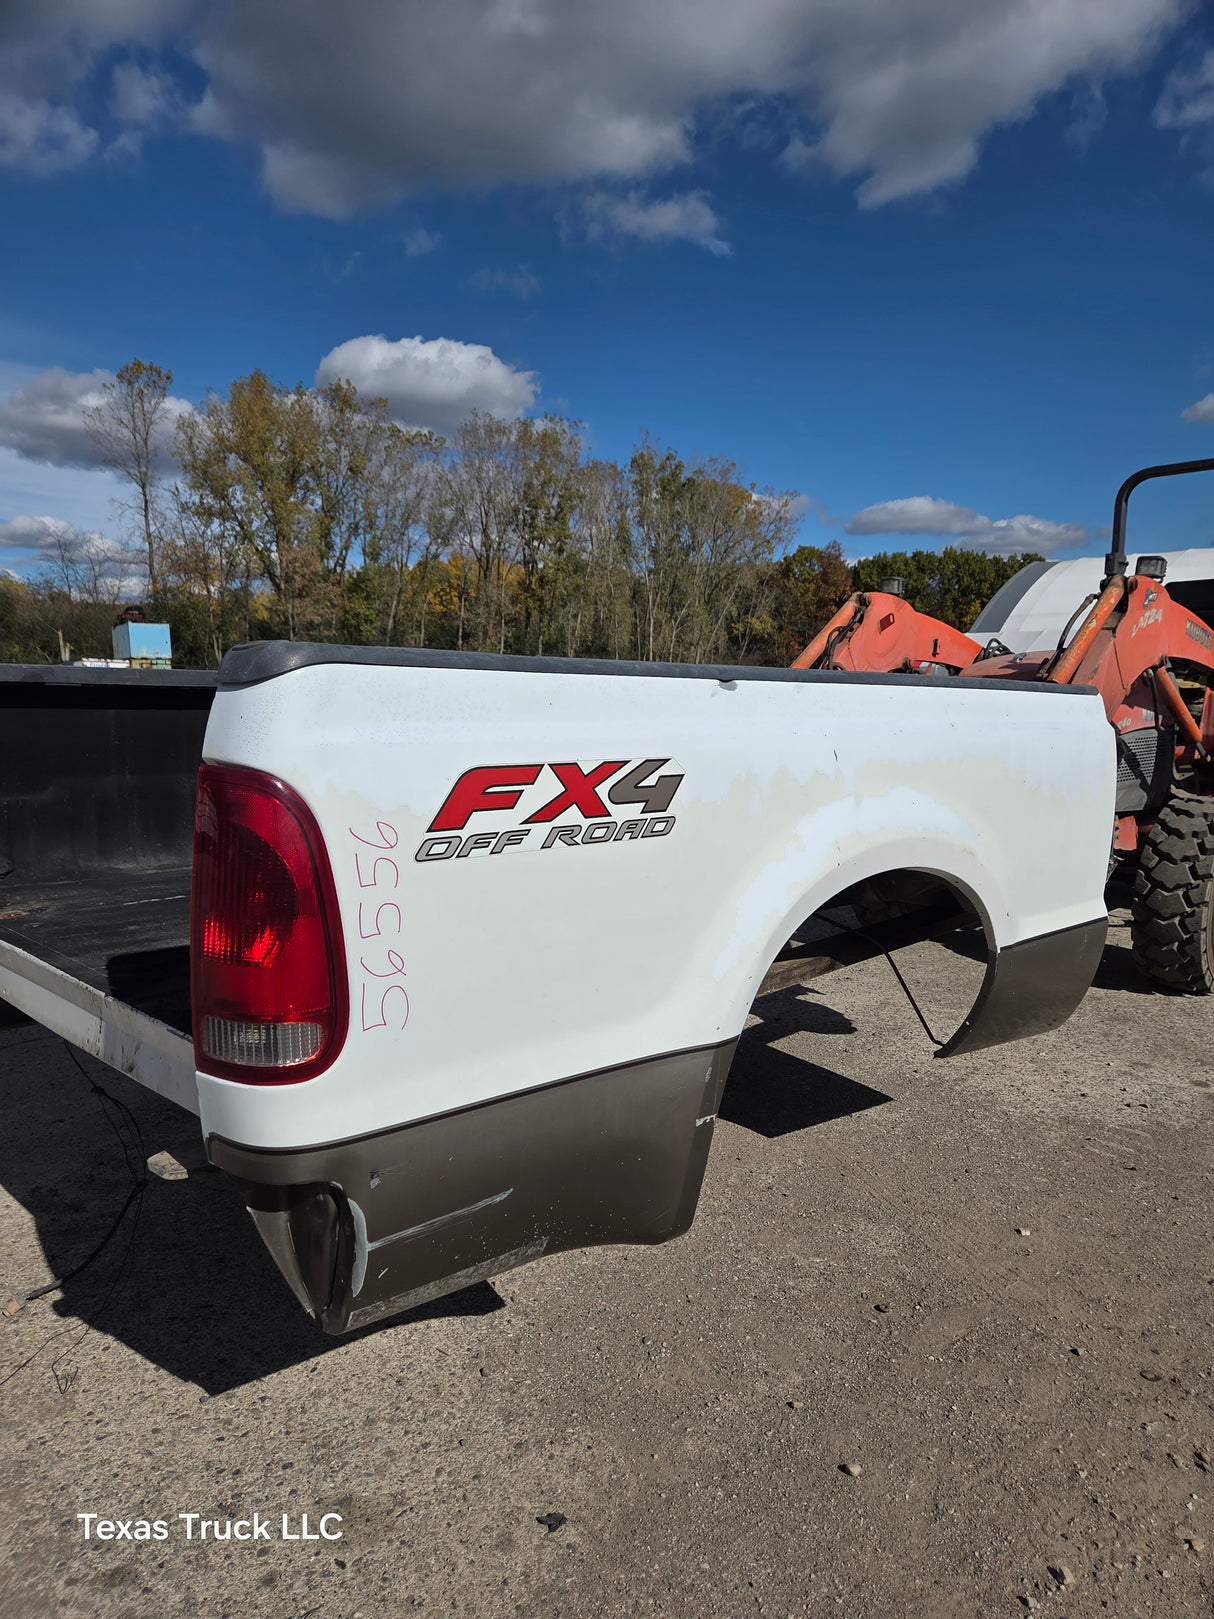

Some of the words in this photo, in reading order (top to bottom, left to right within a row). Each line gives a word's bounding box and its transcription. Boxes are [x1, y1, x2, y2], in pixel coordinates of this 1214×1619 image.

[1185, 617, 1212, 651] KUBOTA
[426, 758, 685, 833] FX4
[414, 828, 532, 863] OFF
[540, 815, 676, 849] ROAD
[349, 821, 410, 1032] 56556
